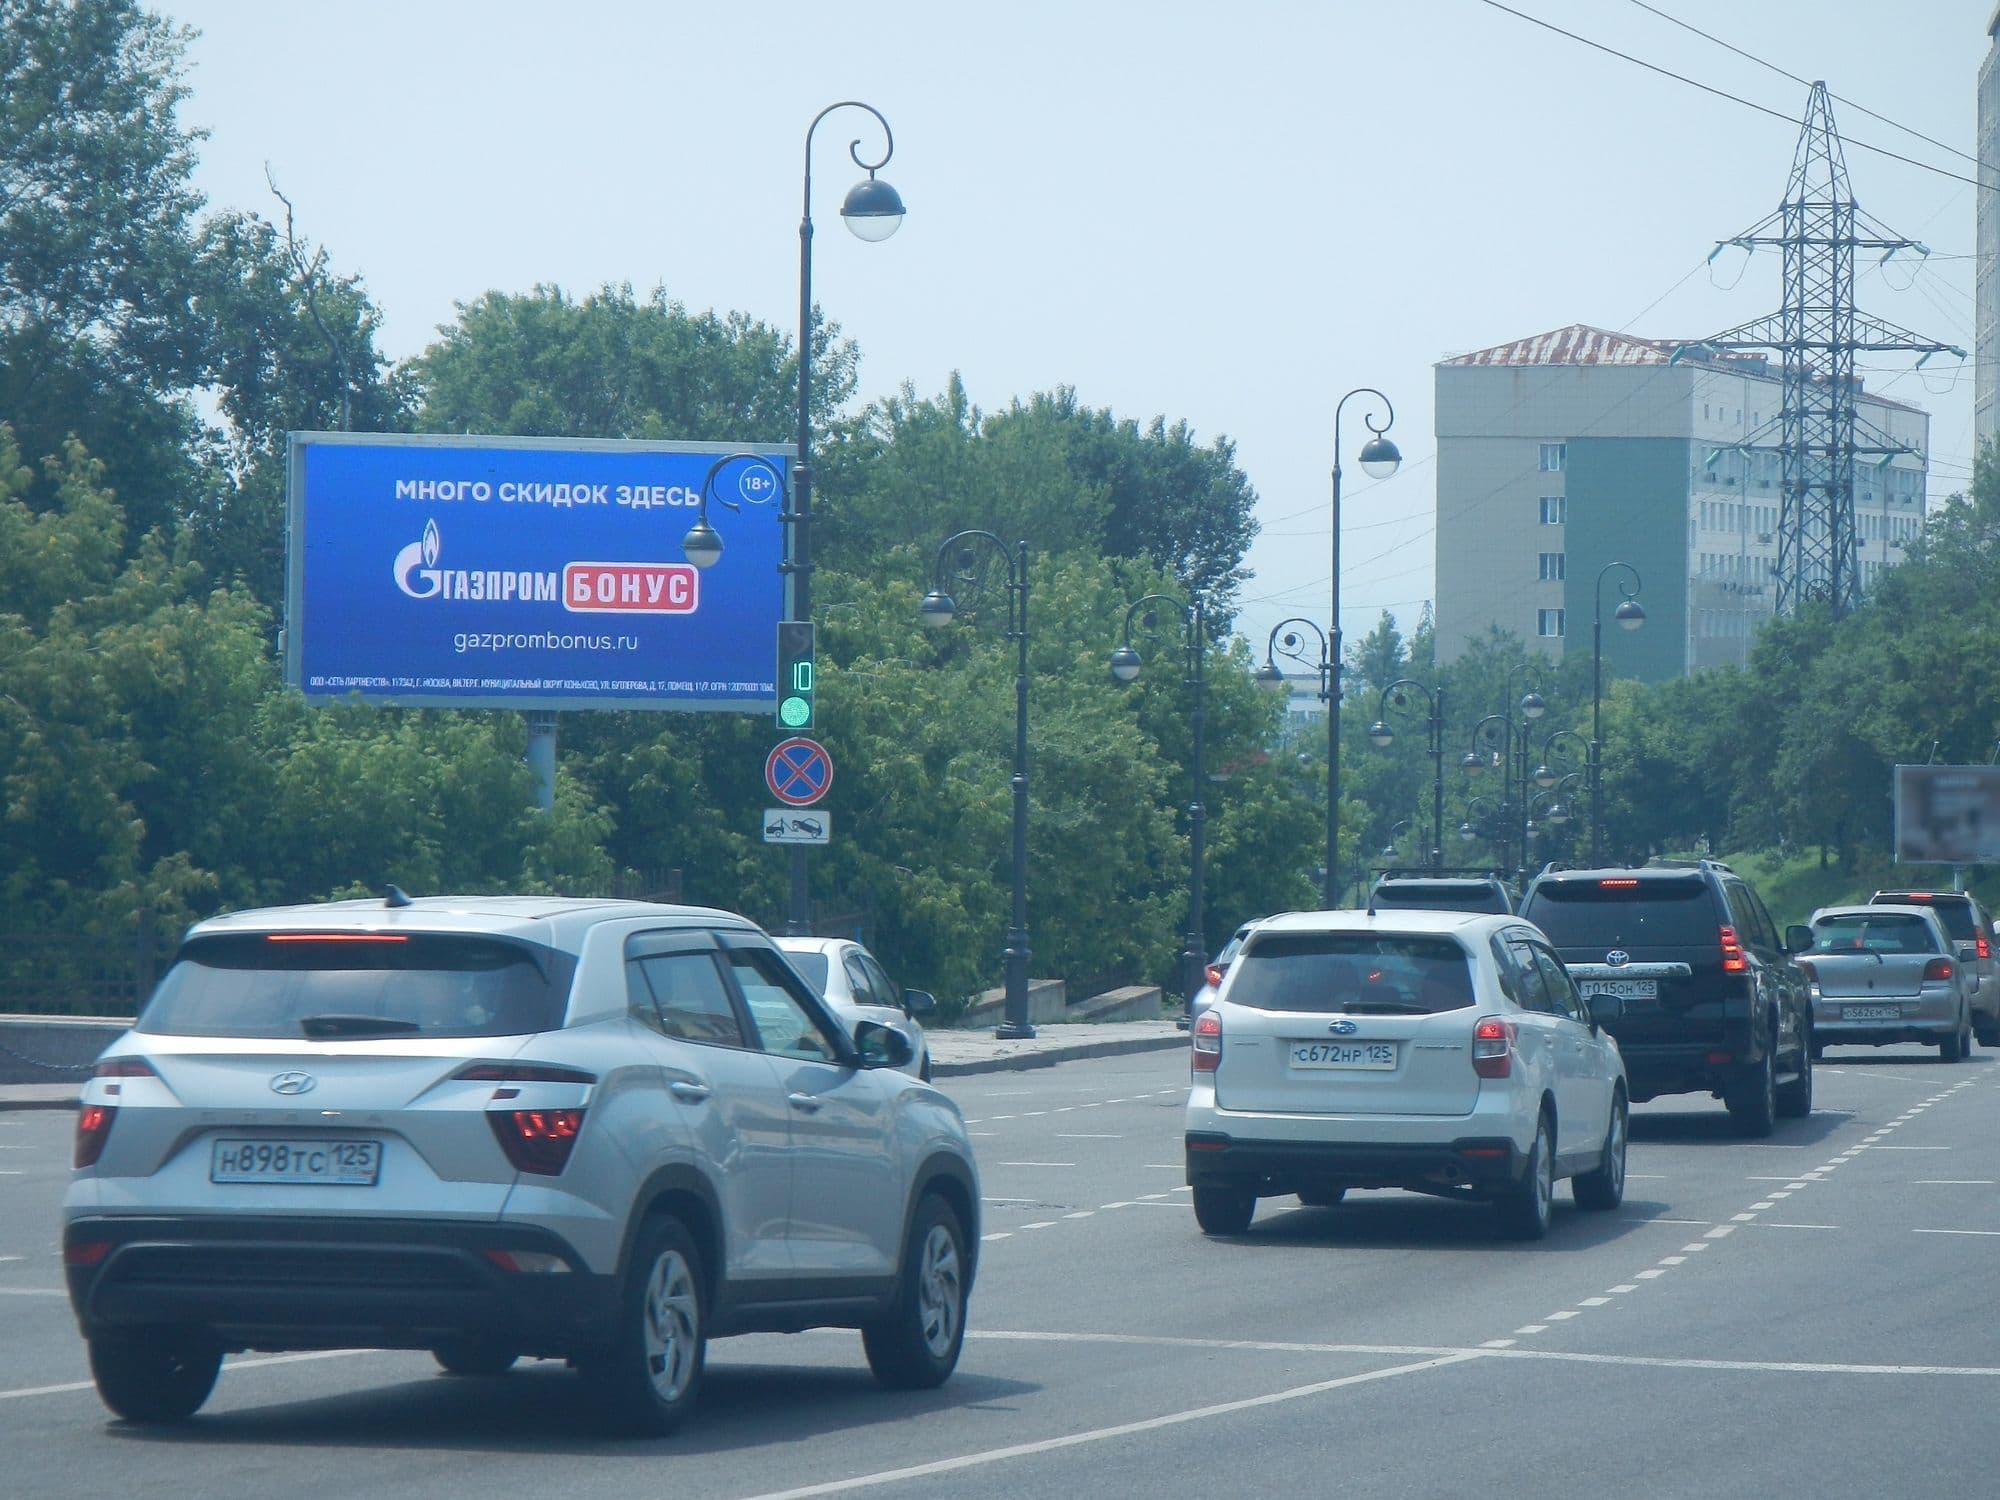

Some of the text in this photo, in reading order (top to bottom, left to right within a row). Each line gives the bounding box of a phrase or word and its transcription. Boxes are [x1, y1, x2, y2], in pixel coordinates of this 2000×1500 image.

[395, 480, 700, 509] МНОГО СКИДОК ЗДЕСЬ
[744, 477, 771, 490] 18+
[443, 570, 688, 604] ГАЗПРОМ БОНУС
[453, 630, 639, 652] gazprombonus.ru
[793, 662, 812, 690] 10
[1585, 981, 1655, 995] Т015ОН 125
[1298, 1045, 1389, 1063] С672НР 125
[221, 1144, 372, 1173] Н898ТС 125
